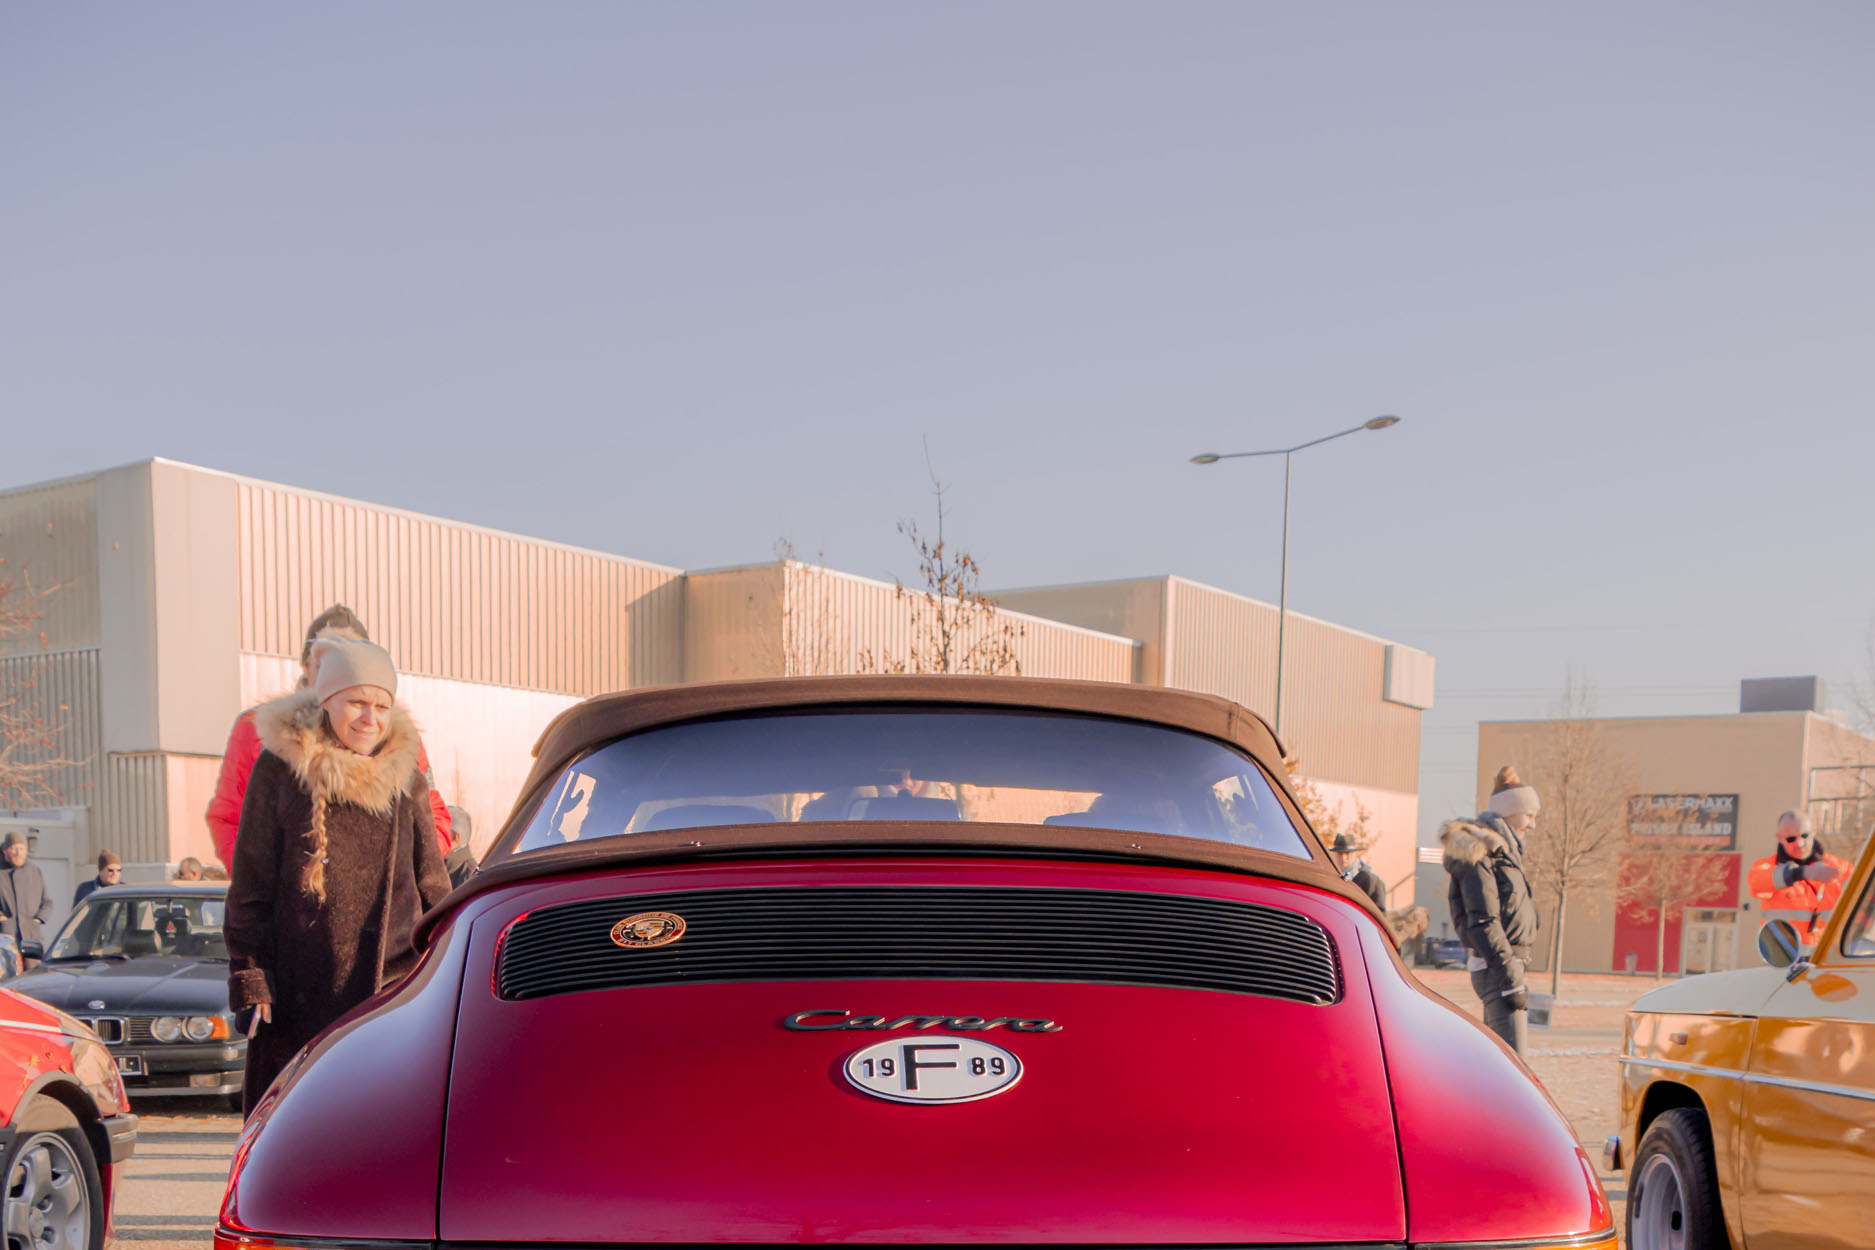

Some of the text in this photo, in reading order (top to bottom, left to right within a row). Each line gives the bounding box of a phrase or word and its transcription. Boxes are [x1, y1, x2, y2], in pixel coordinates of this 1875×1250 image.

[784, 1009, 1063, 1032] Carrera
[863, 1044, 1006, 1090] 19 F 89
